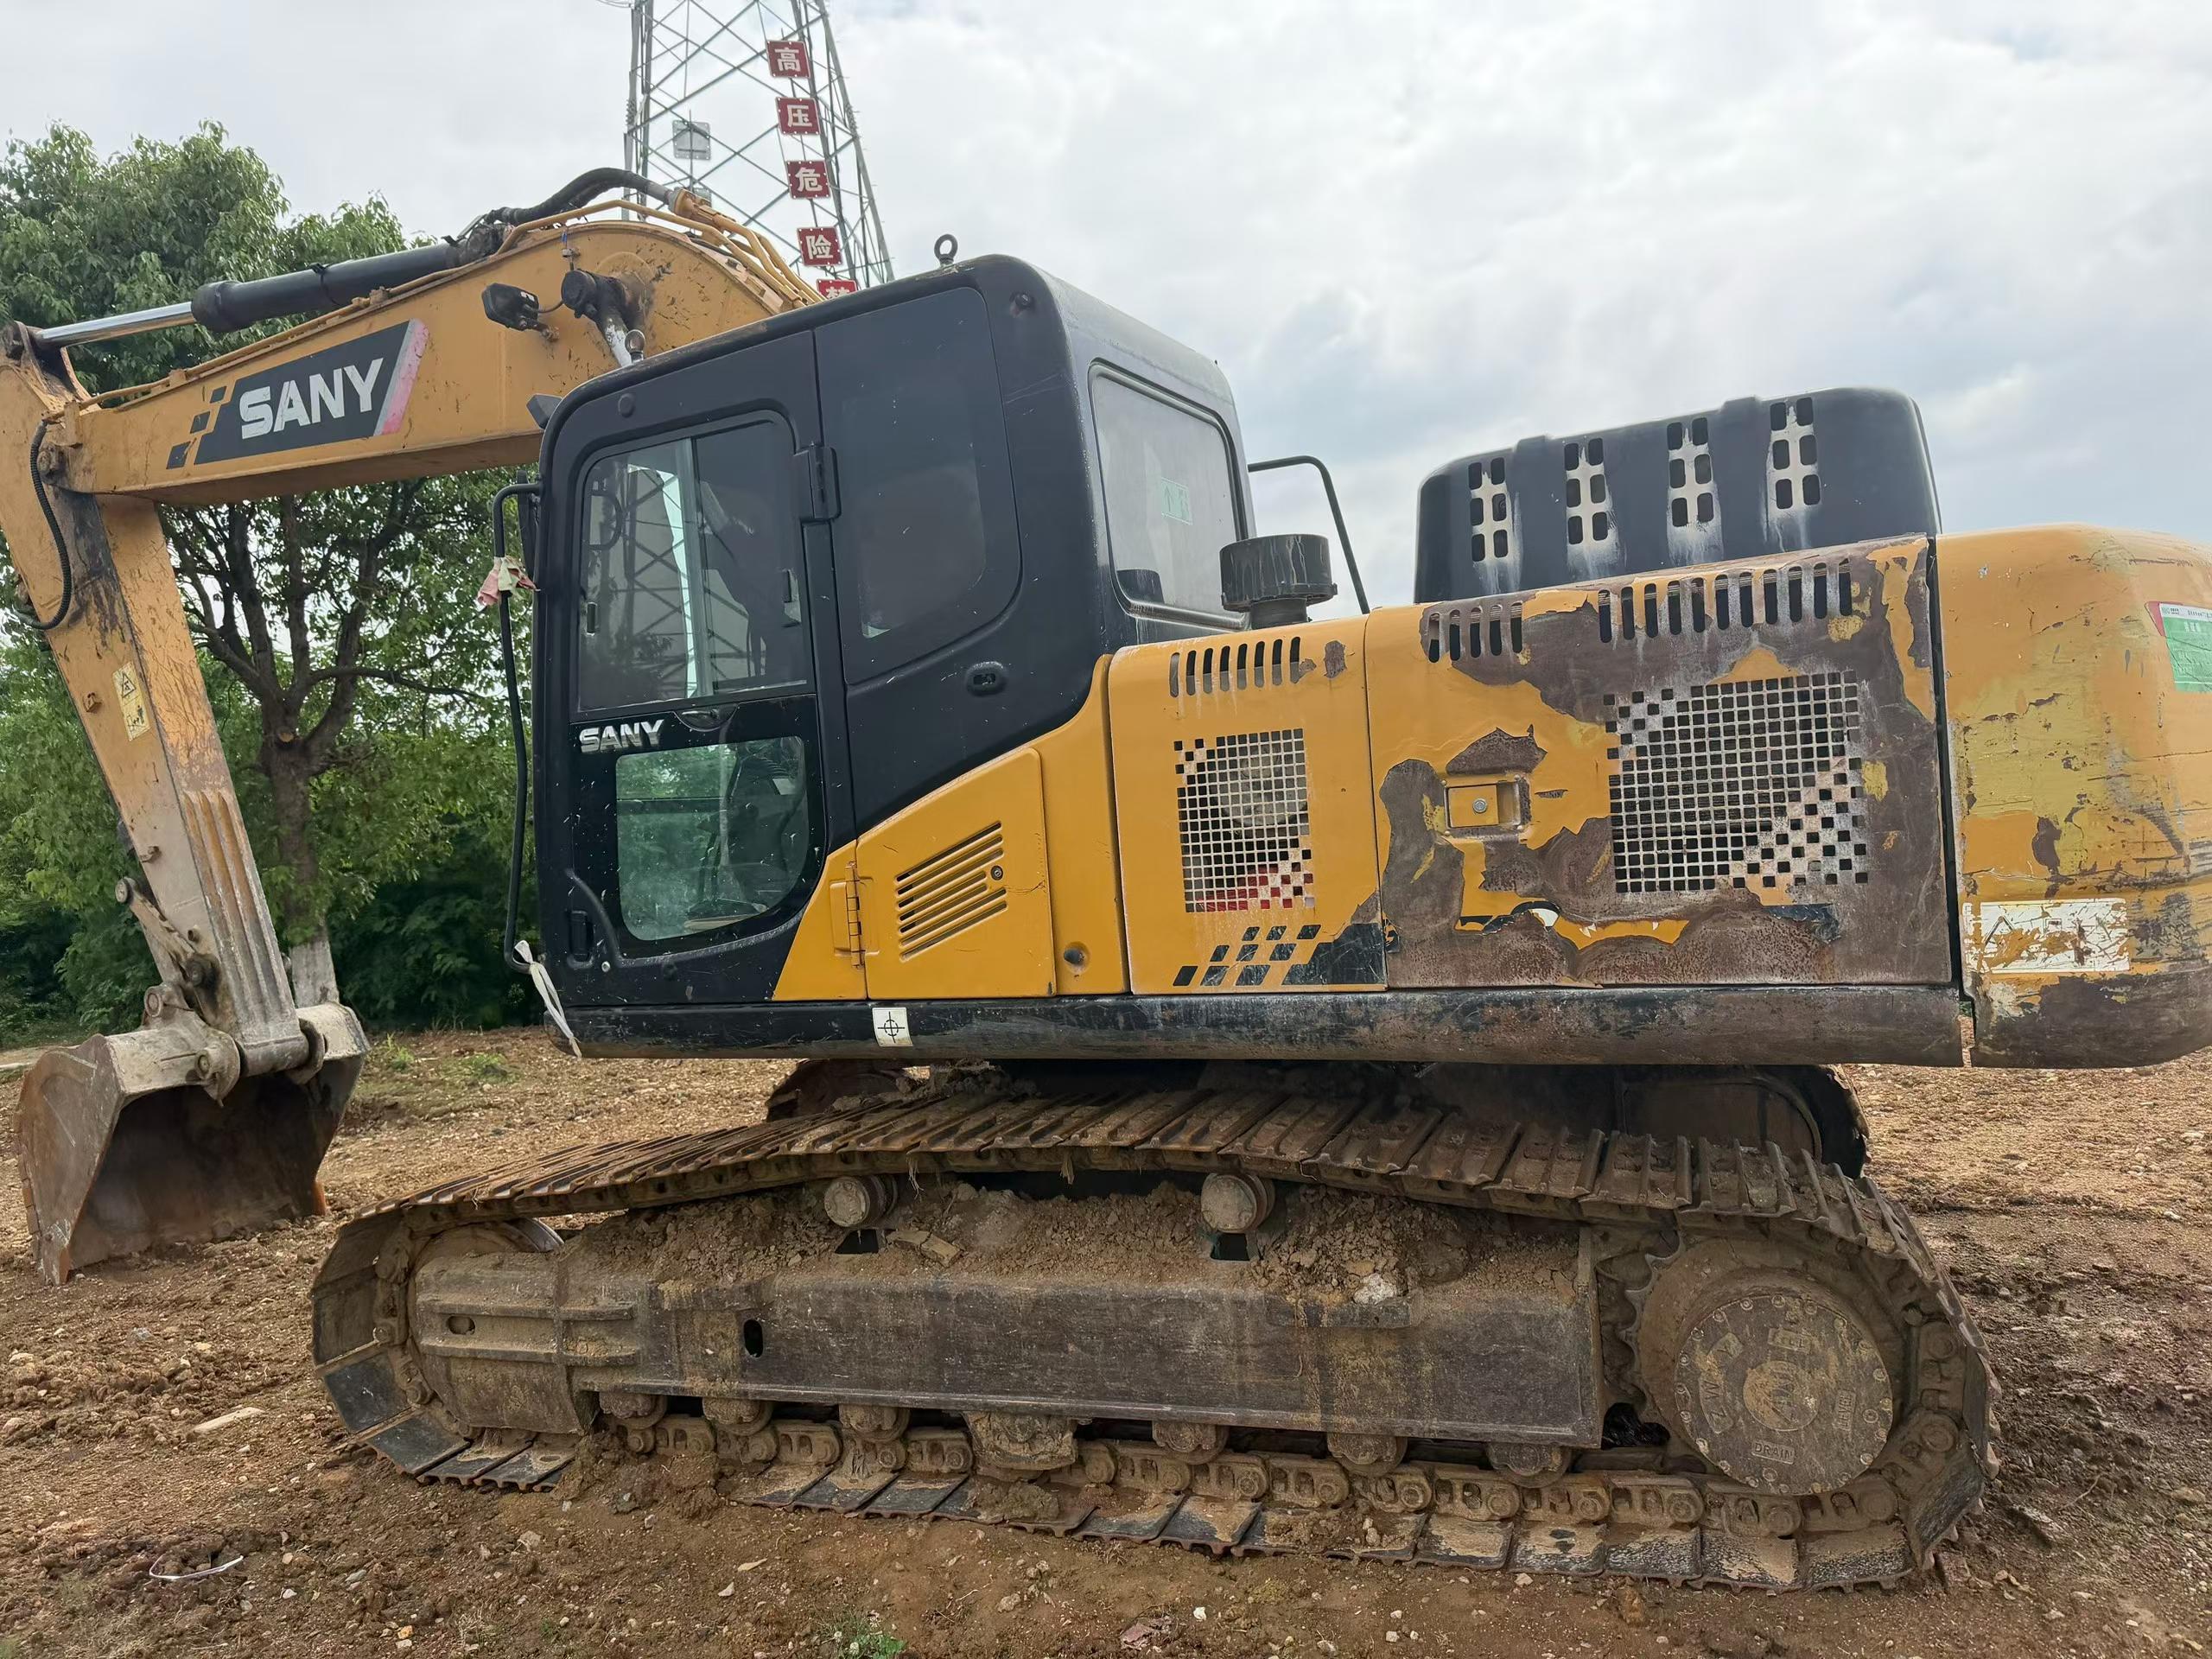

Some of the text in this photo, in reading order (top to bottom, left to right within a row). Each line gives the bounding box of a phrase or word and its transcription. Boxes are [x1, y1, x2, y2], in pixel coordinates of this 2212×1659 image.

[239, 357, 384, 440] SANY
[579, 719, 664, 753] SANY
[1754, 1442, 1794, 1460] DRAIN
